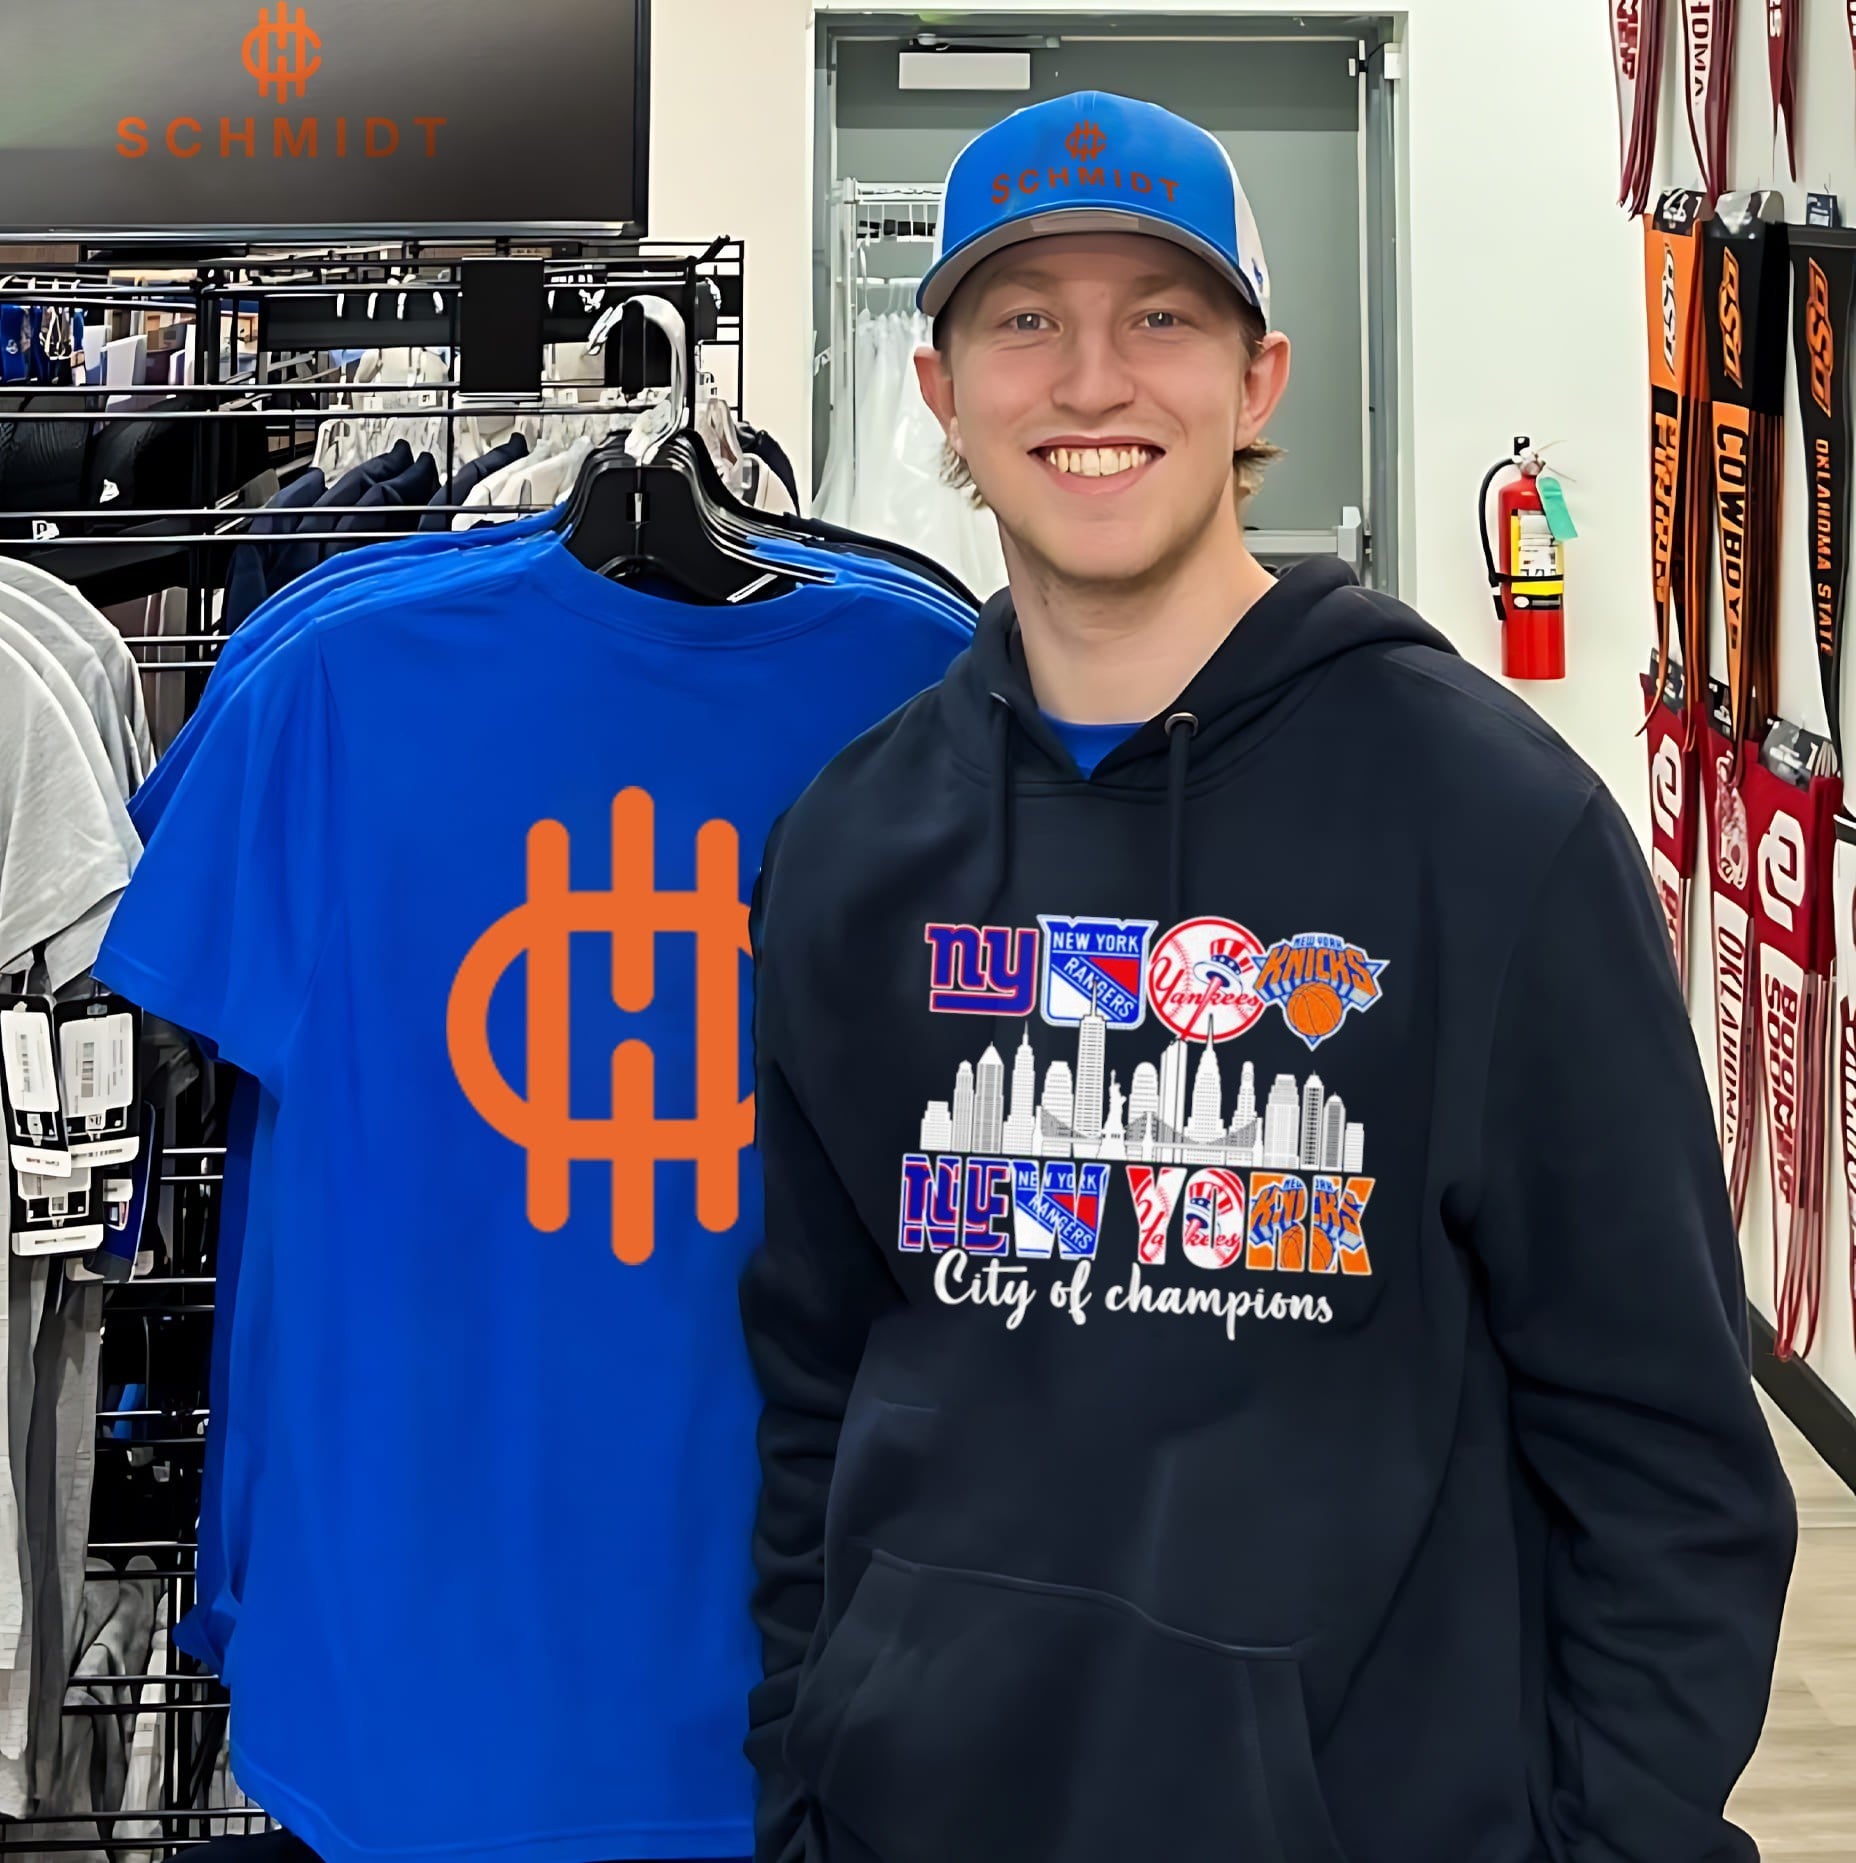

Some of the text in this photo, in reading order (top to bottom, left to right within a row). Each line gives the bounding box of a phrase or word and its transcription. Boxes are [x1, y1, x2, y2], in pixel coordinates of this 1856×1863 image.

[115, 116, 448, 159] SCHMIDT
[991, 165, 1180, 205] SCHMIDT
[1814, 438, 1832, 570] OKLAHOMA
[1716, 424, 1750, 650] COWBOY
[1052, 931, 1139, 953] NEW YORK
[1255, 943, 1377, 1000] KNICKS
[1063, 957, 1137, 1020] RANGERS
[1150, 955, 1263, 1012] Yankees
[899, 1153, 1376, 1276] NEW YORK
[934, 1248, 1334, 1341] City of champions
